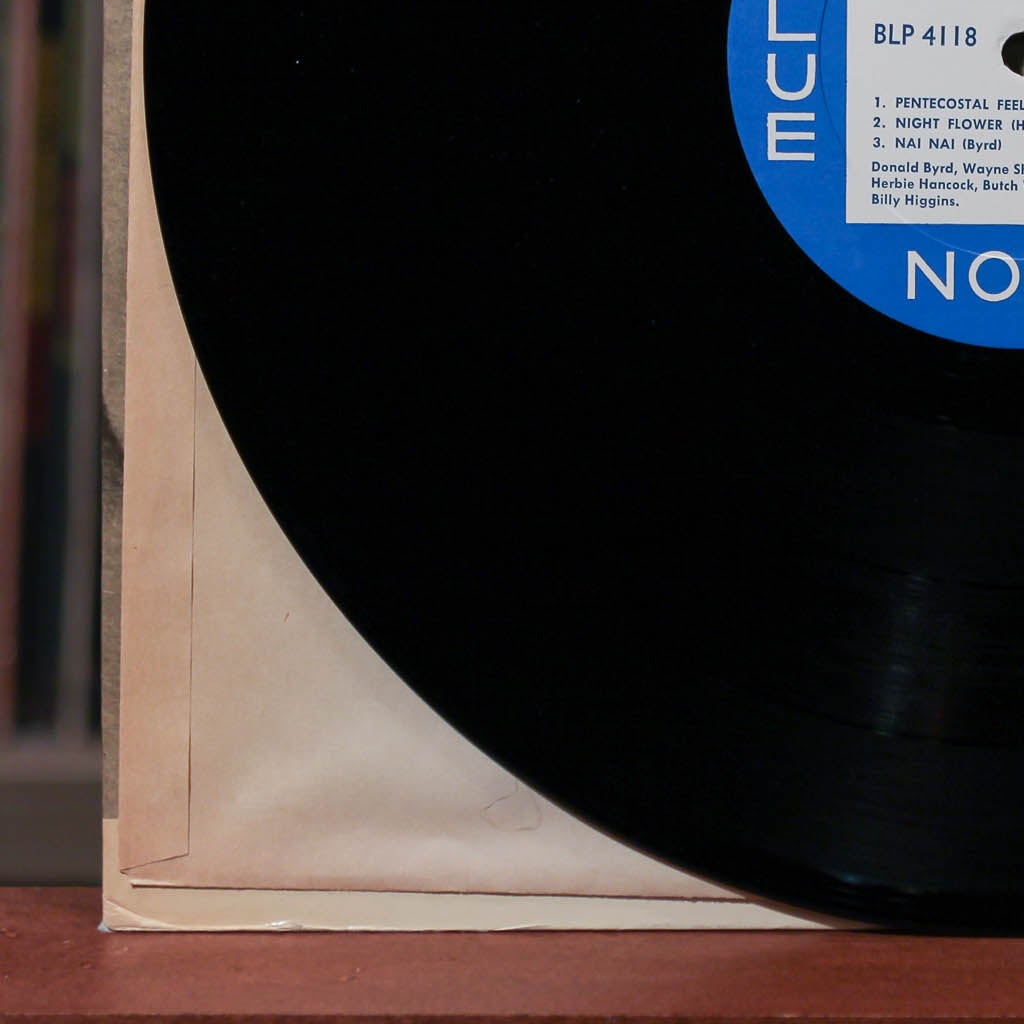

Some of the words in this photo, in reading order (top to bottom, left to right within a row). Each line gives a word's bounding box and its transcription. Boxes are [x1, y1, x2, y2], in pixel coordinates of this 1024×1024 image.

[874, 23, 915, 46] BLP
[921, 25, 977, 47] 4118
[874, 96, 886, 108] 1.
[895, 96, 989, 110] PENTECOSTAL
[873, 116, 886, 129] 2.
[895, 117, 940, 129] NIGHT
[948, 118, 1003, 131] FLOWER
[872, 136, 885, 149] 3.
[895, 137, 921, 149] NAI
[928, 138, 955, 150] NAI
[962, 138, 1002, 153] (Byrd)
[871, 161, 919, 173] Donald
[923, 161, 958, 176] Byrd,
[962, 162, 1009, 177] Wayne
[871, 177, 915, 190] Herbie
[919, 178, 978, 193] Hancock,
[982, 179, 1018, 192] Butch
[871, 193, 901, 208] Billy
[905, 194, 960, 209] Higgins.
